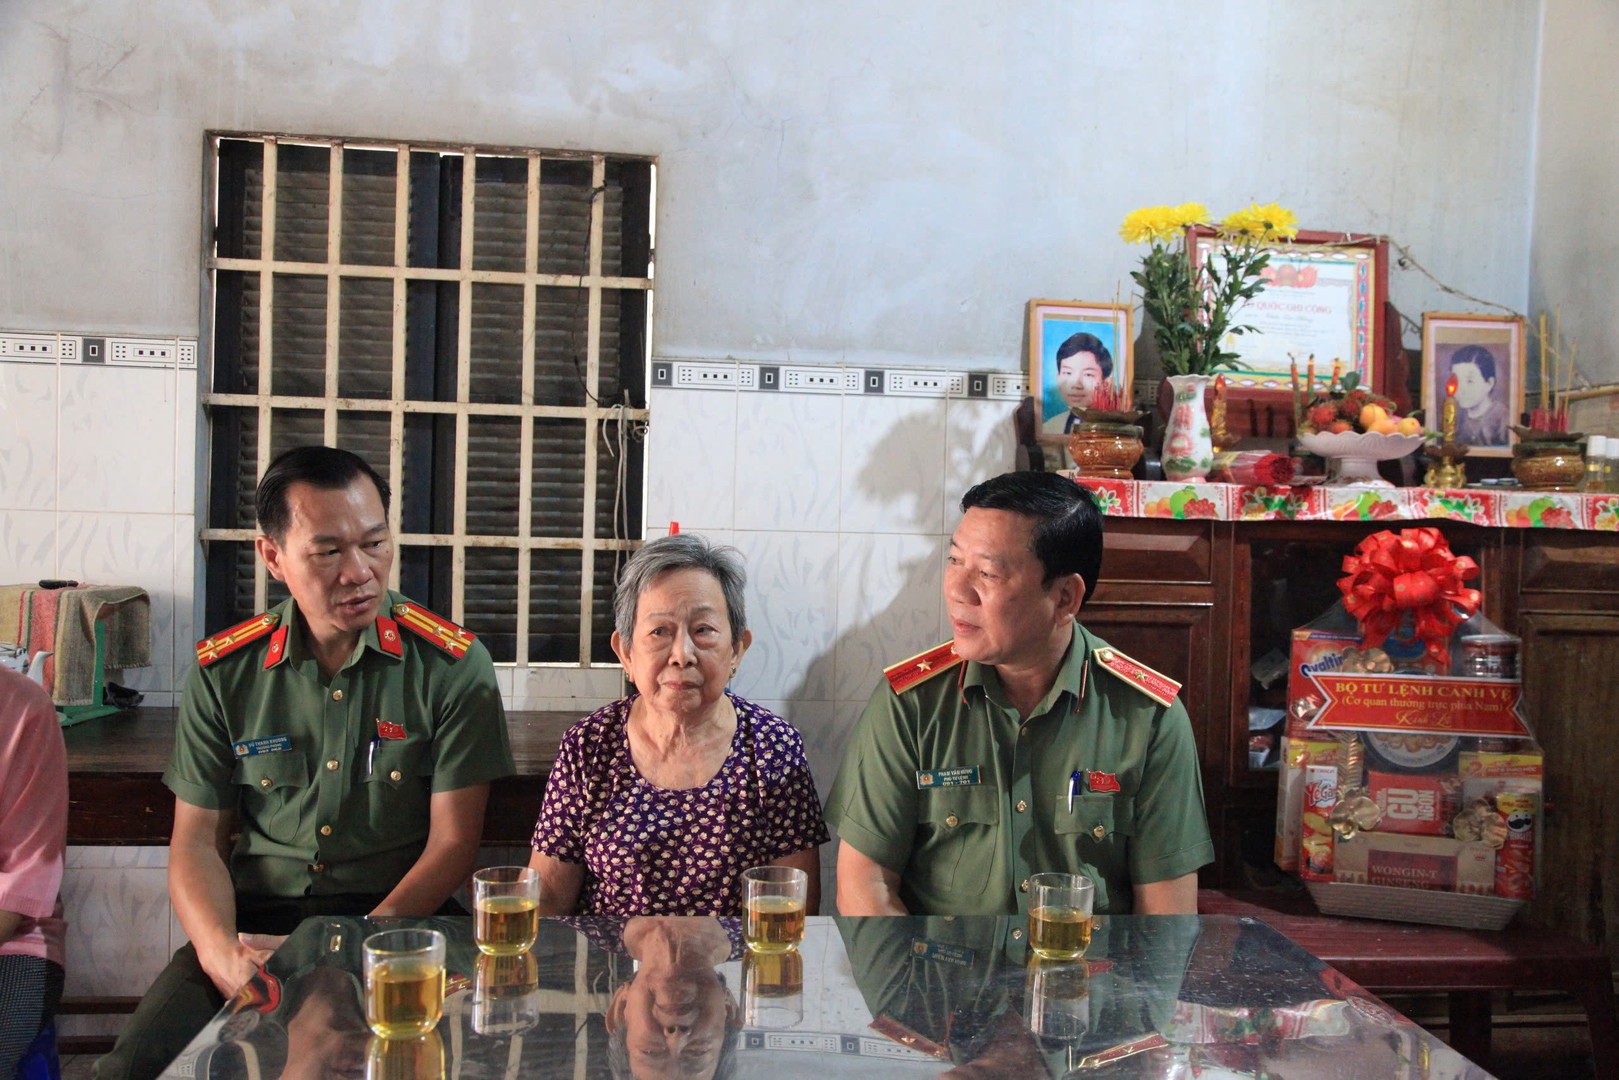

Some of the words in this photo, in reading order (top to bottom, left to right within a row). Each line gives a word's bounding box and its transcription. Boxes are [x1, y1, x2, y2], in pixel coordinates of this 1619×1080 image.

[1335, 682, 1358, 695] BỘ
[1361, 682, 1386, 694] TƯ
[1388, 683, 1433, 697] LỆNH
[1490, 687, 1511, 701] VỆ
[1363, 699, 1387, 708] quan
[1387, 787, 1419, 820] GU
[1417, 789, 1435, 821] NGON
